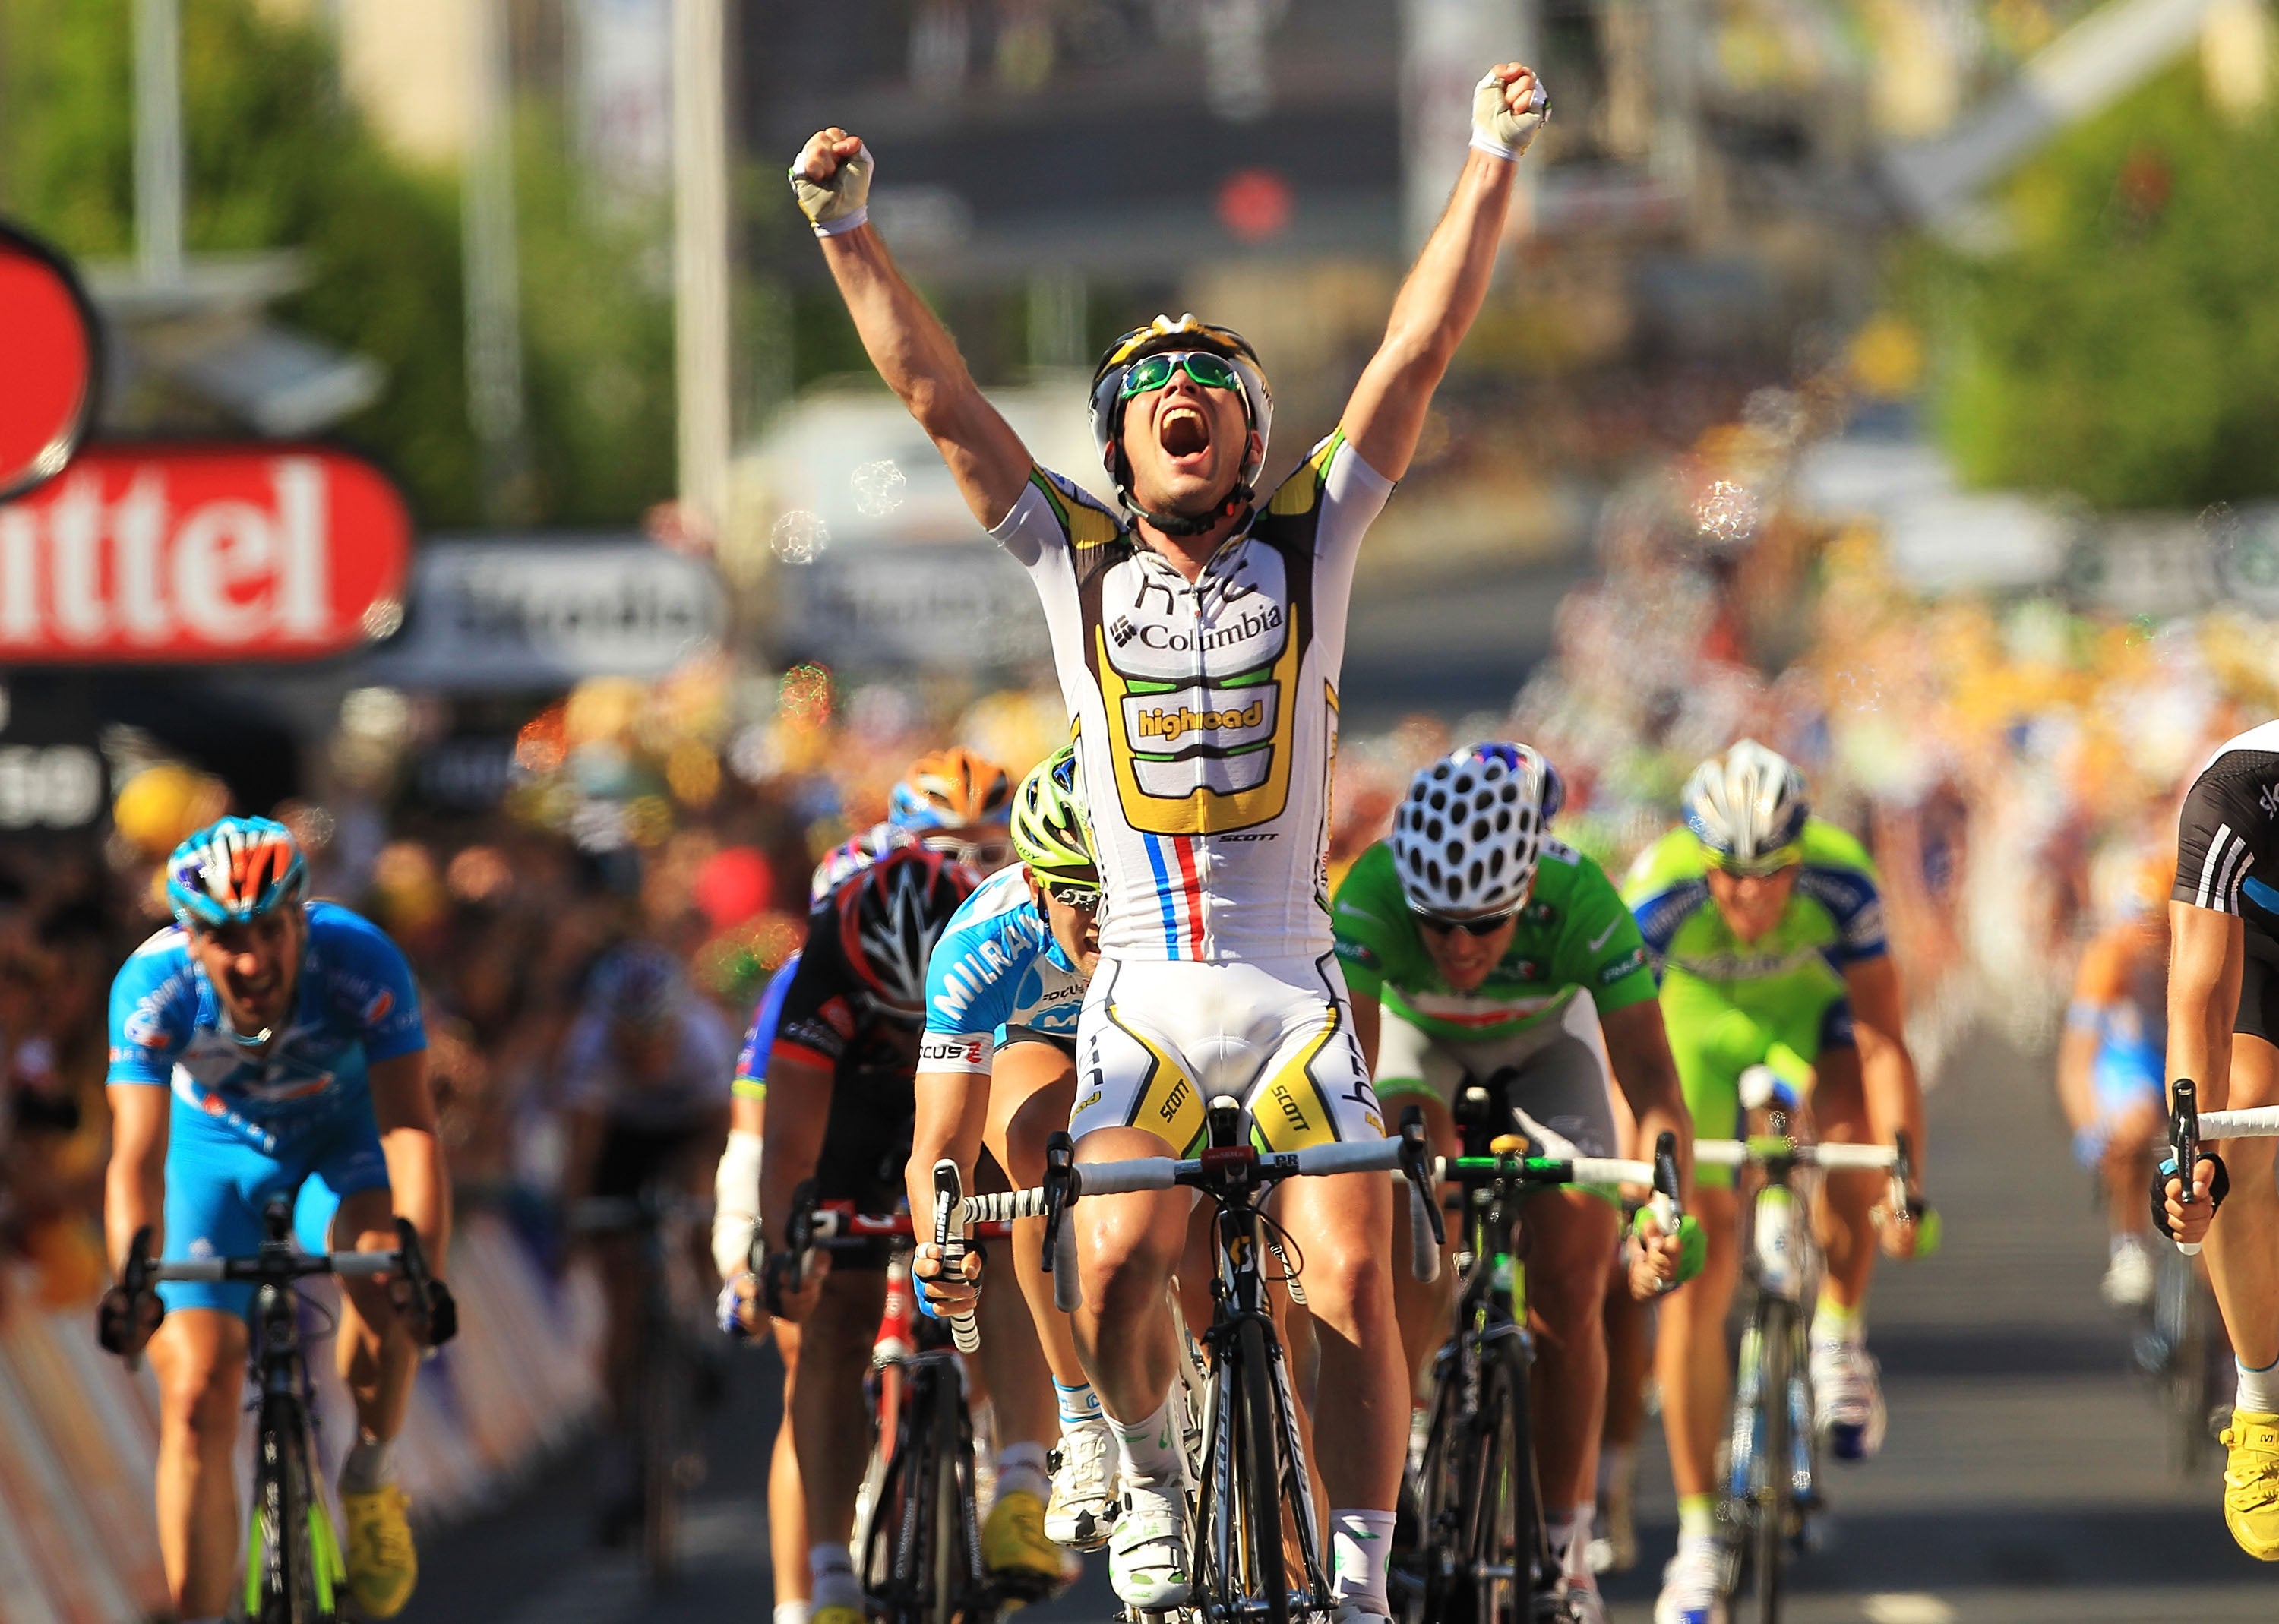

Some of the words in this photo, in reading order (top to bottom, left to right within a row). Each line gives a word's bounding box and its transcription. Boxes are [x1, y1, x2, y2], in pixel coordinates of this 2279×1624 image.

[1140, 605, 1282, 651] Columbia
[1139, 700, 1263, 741] highroad
[1219, 833, 1279, 842] SCOTT
[920, 1046, 962, 1059] CUS
[1159, 1078, 1190, 1123] SCOTT
[1271, 1085, 1310, 1131] SCOTT
[936, 1190, 950, 1243] SRAM
